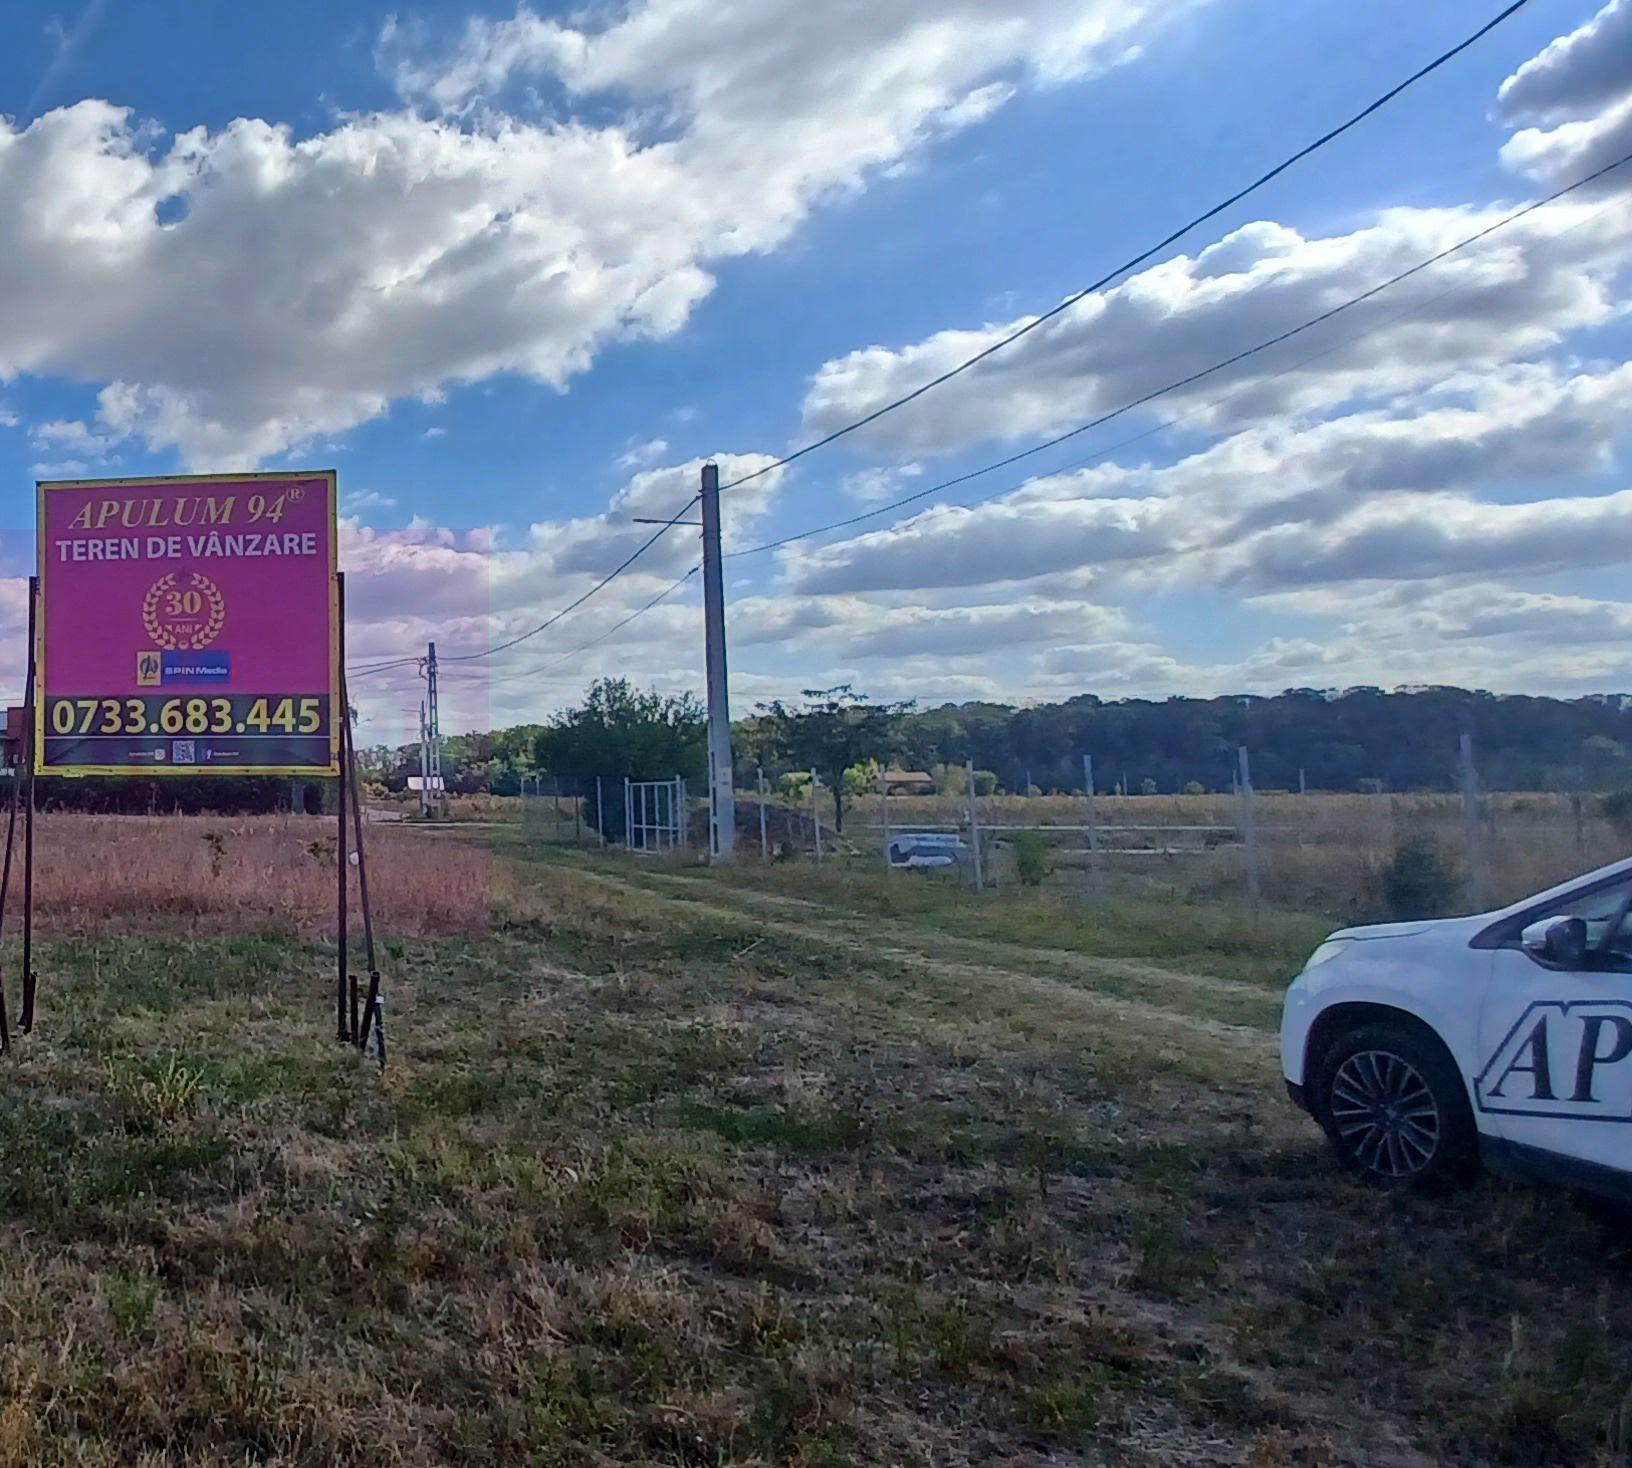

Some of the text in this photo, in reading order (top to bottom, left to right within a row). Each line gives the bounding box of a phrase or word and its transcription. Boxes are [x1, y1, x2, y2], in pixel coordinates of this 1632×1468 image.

[67, 495, 236, 530] APULUM
[55, 531, 317, 562] TEREN DE VÂNZARE
[165, 591, 202, 615] 30
[175, 624, 192, 634] ANI
[52, 698, 321, 734] 0733.683.445
[1486, 1013, 1632, 1103] AP
